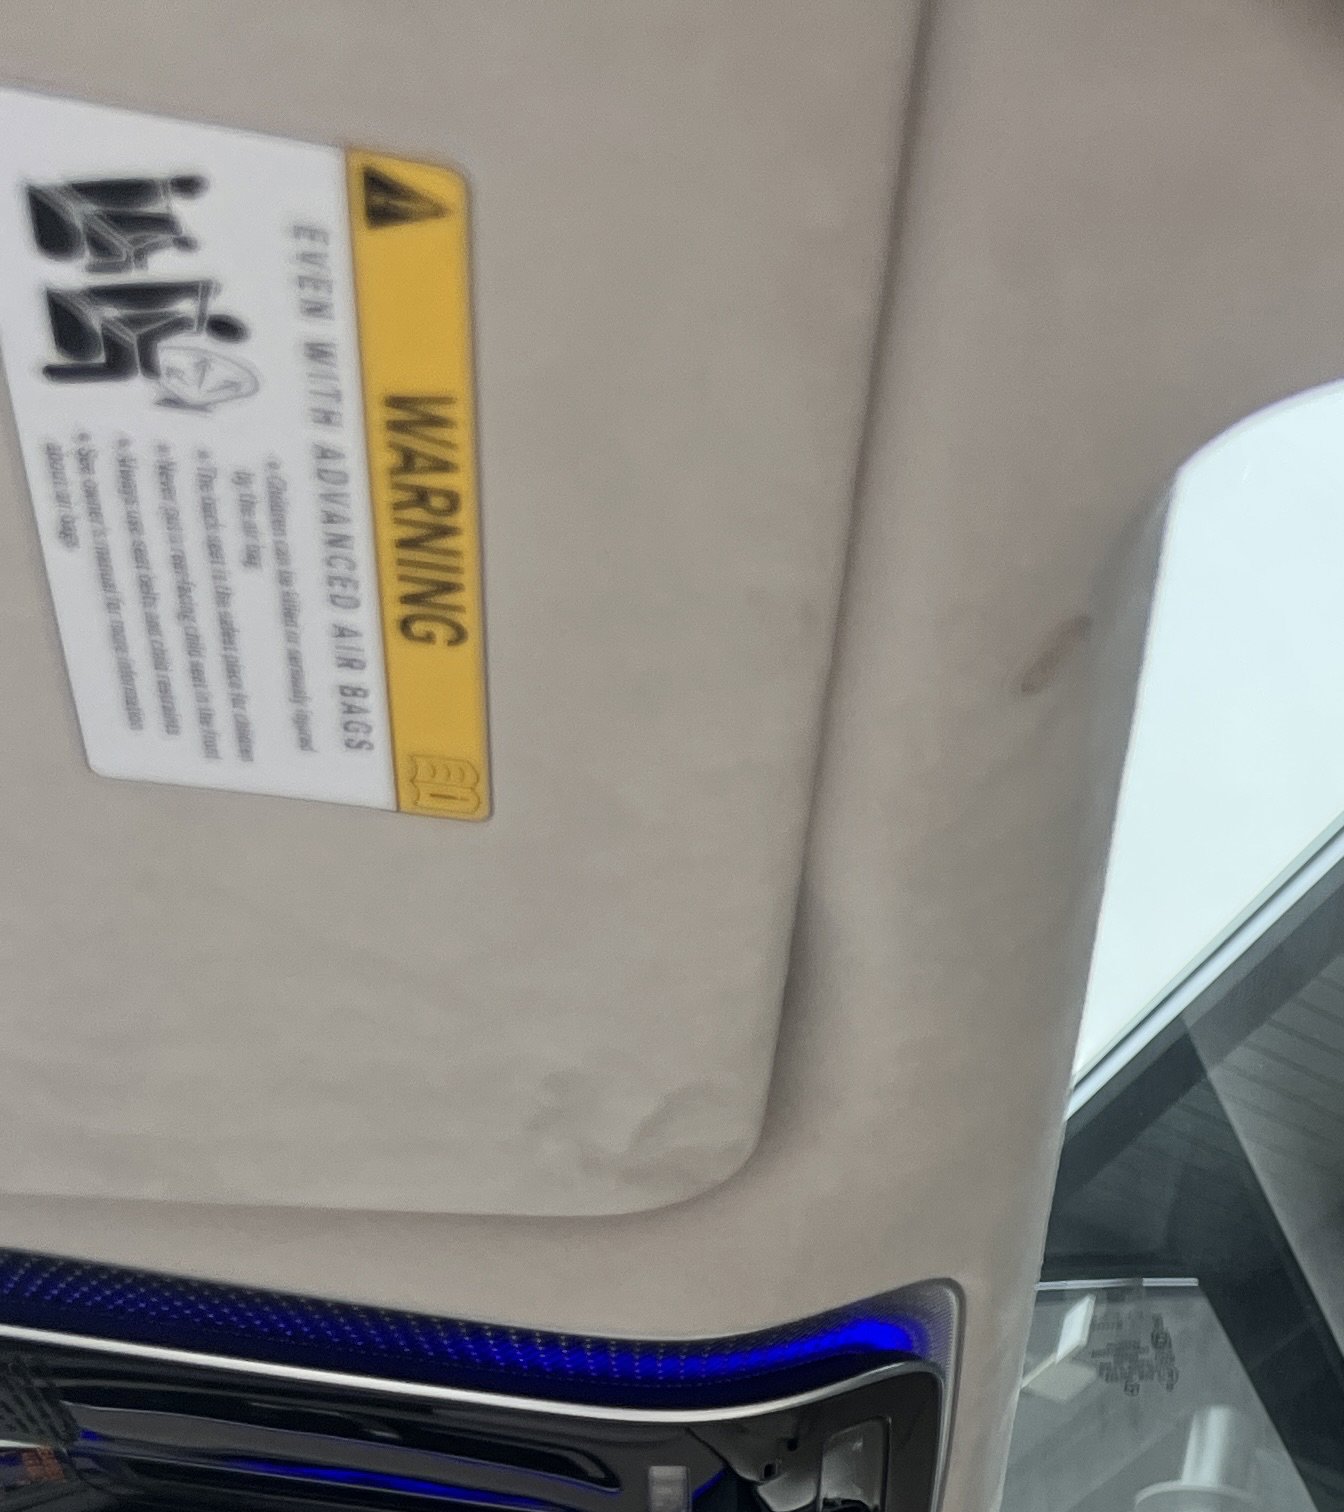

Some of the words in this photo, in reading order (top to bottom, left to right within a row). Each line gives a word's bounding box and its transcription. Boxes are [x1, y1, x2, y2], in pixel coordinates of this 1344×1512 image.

[290, 222, 334, 319] EVEN
[301, 341, 343, 426] WITH
[312, 442, 362, 610] ADVANCED
[381, 391, 470, 646] WARNING
[330, 624, 368, 669] AIR
[337, 685, 374, 752] BAGS
